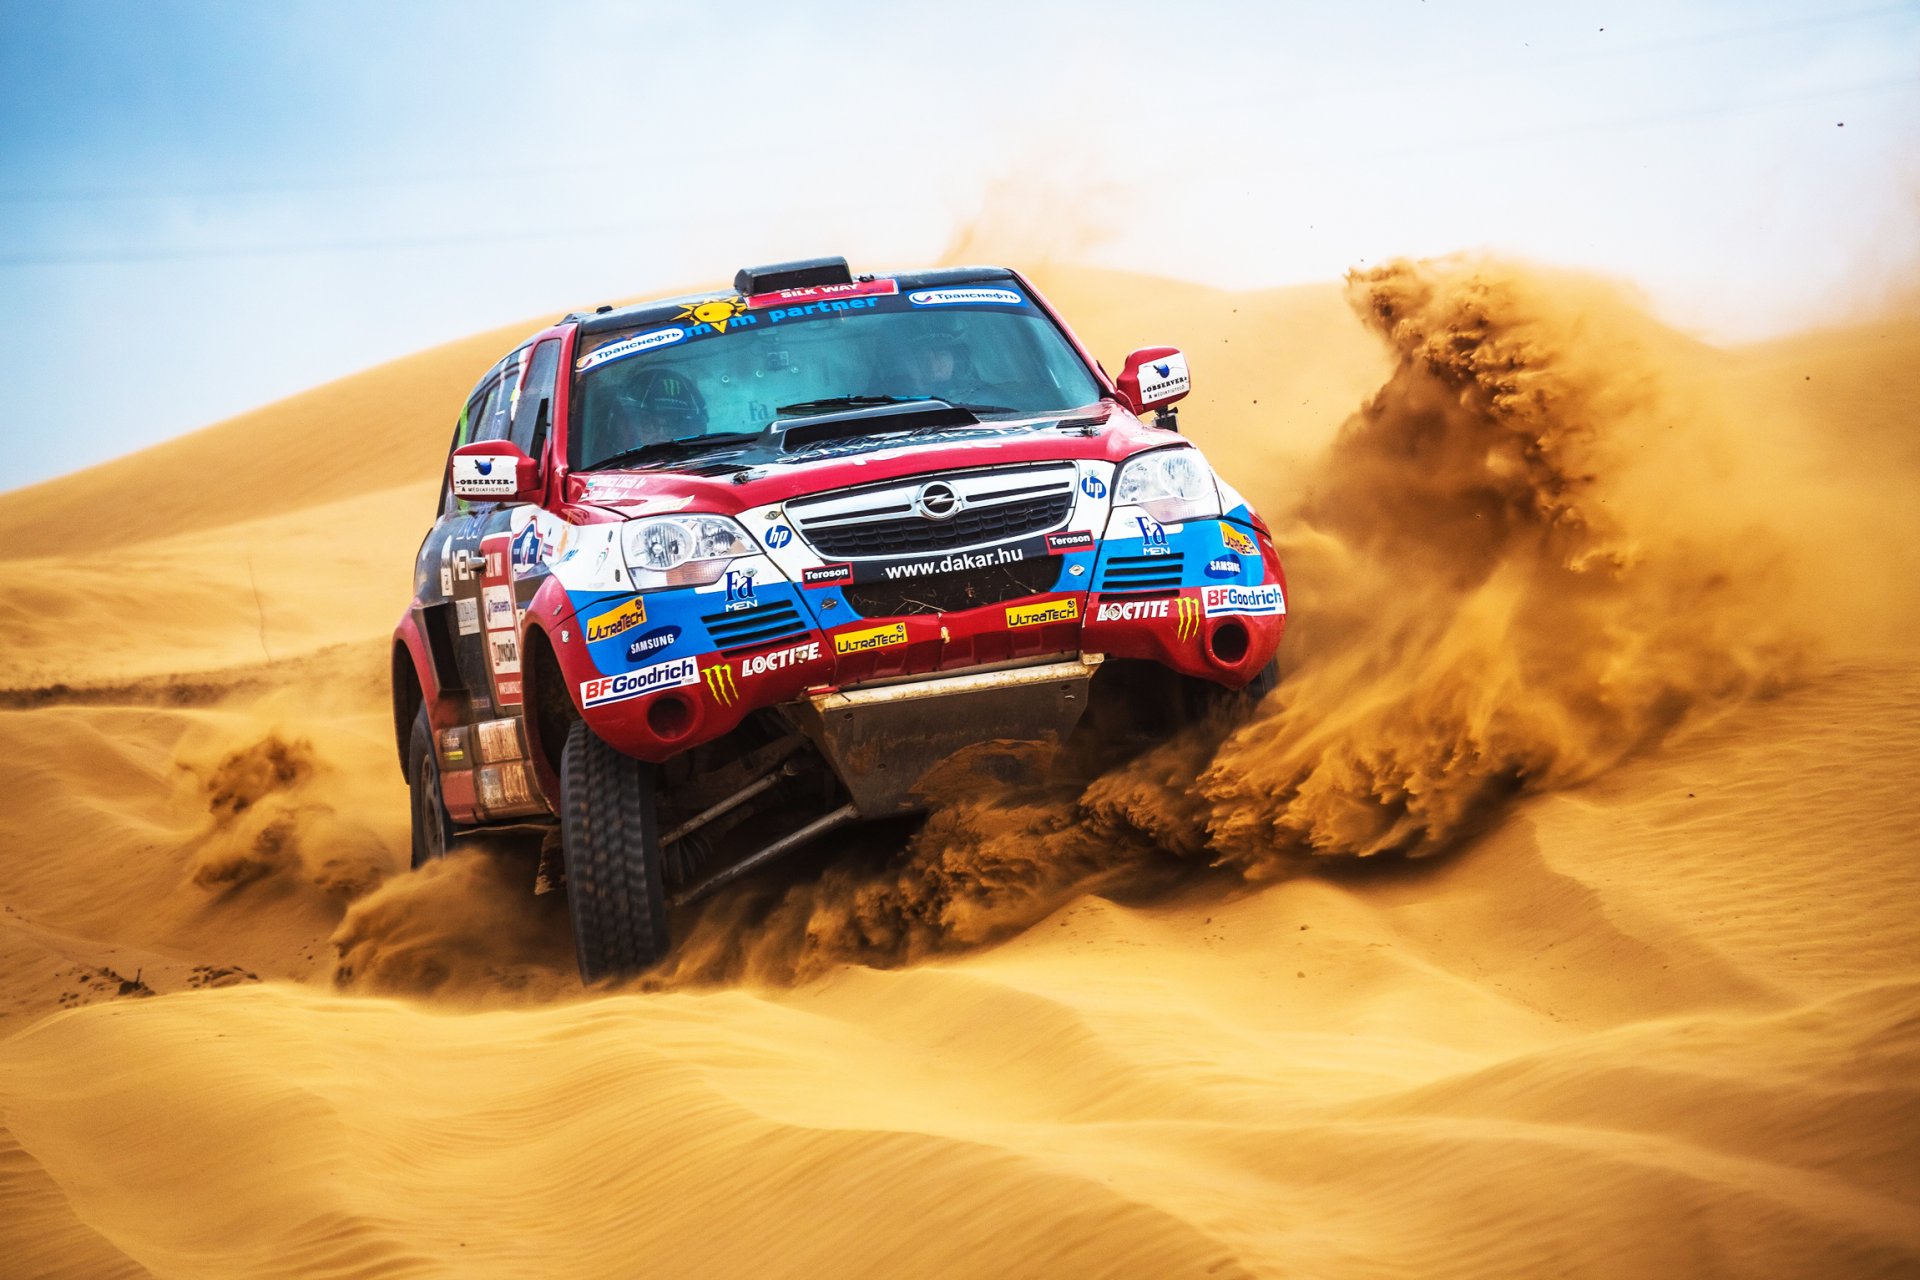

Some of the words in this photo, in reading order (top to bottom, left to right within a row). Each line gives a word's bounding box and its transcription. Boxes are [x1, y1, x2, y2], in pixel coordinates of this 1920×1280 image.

[780, 289, 818, 299] SILK
[820, 283, 859, 294] WAY
[768, 297, 879, 322] partner
[1146, 376, 1185, 393] OBSERVER
[1085, 477, 1104, 499] hp
[767, 526, 791, 549] hp
[1049, 533, 1091, 546] Teroson
[1135, 516, 1168, 546] Fa
[1143, 547, 1171, 556] MEN
[804, 567, 849, 581] Teroson
[885, 548, 1024, 579] www.dakar.hu
[725, 570, 757, 602] Fa
[725, 599, 758, 612] MEN
[1207, 588, 1282, 607] BFGoodrich
[630, 633, 675, 654] SAMSUNG
[585, 660, 695, 700] BFGoodrich
